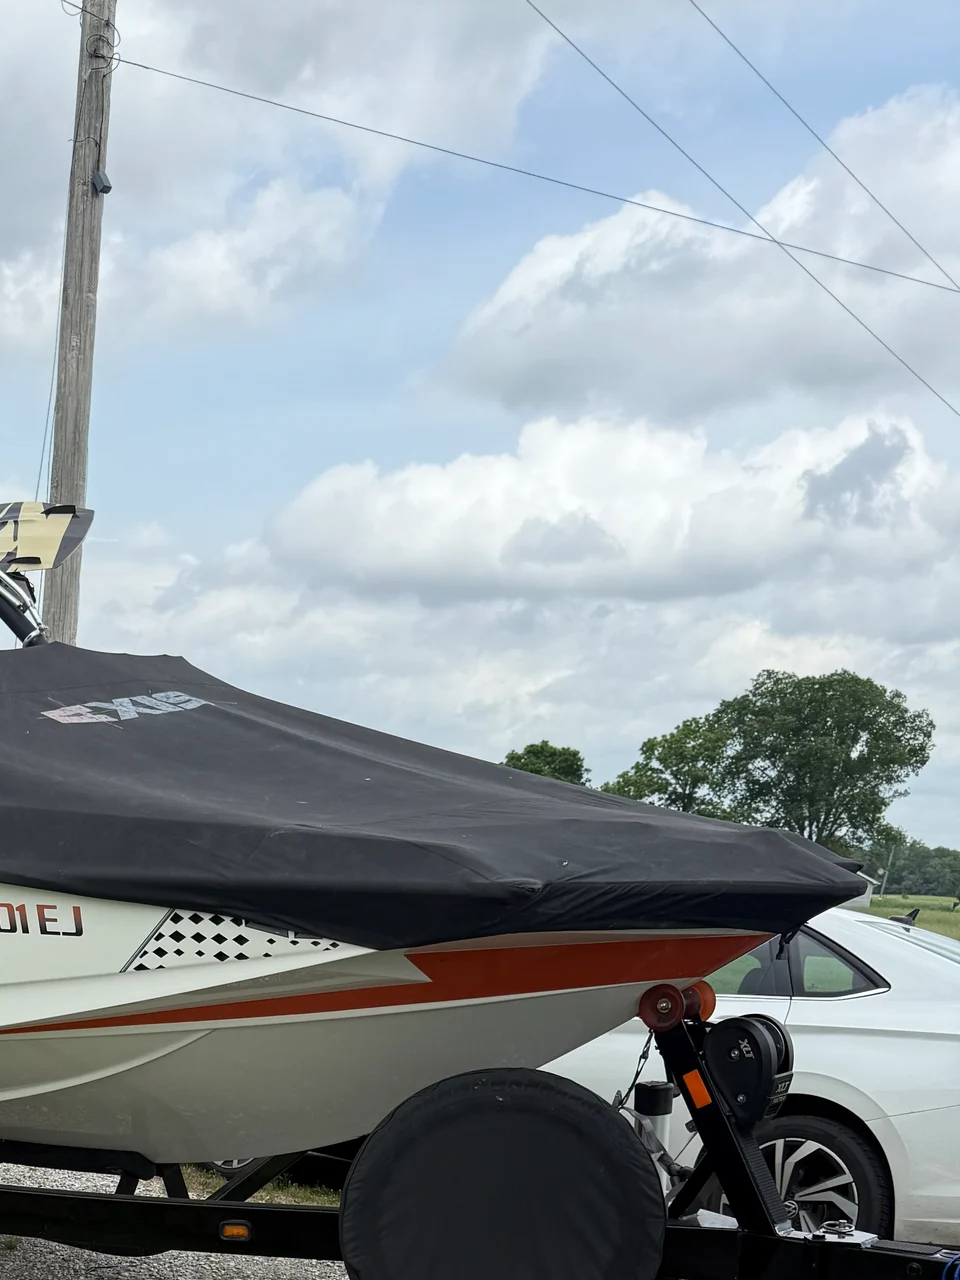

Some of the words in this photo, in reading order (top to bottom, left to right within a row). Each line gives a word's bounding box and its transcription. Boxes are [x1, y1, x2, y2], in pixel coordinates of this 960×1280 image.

[40, 690, 216, 724] AXIS
[36, 904, 84, 937] EJ
[739, 1038, 755, 1059] XLT
